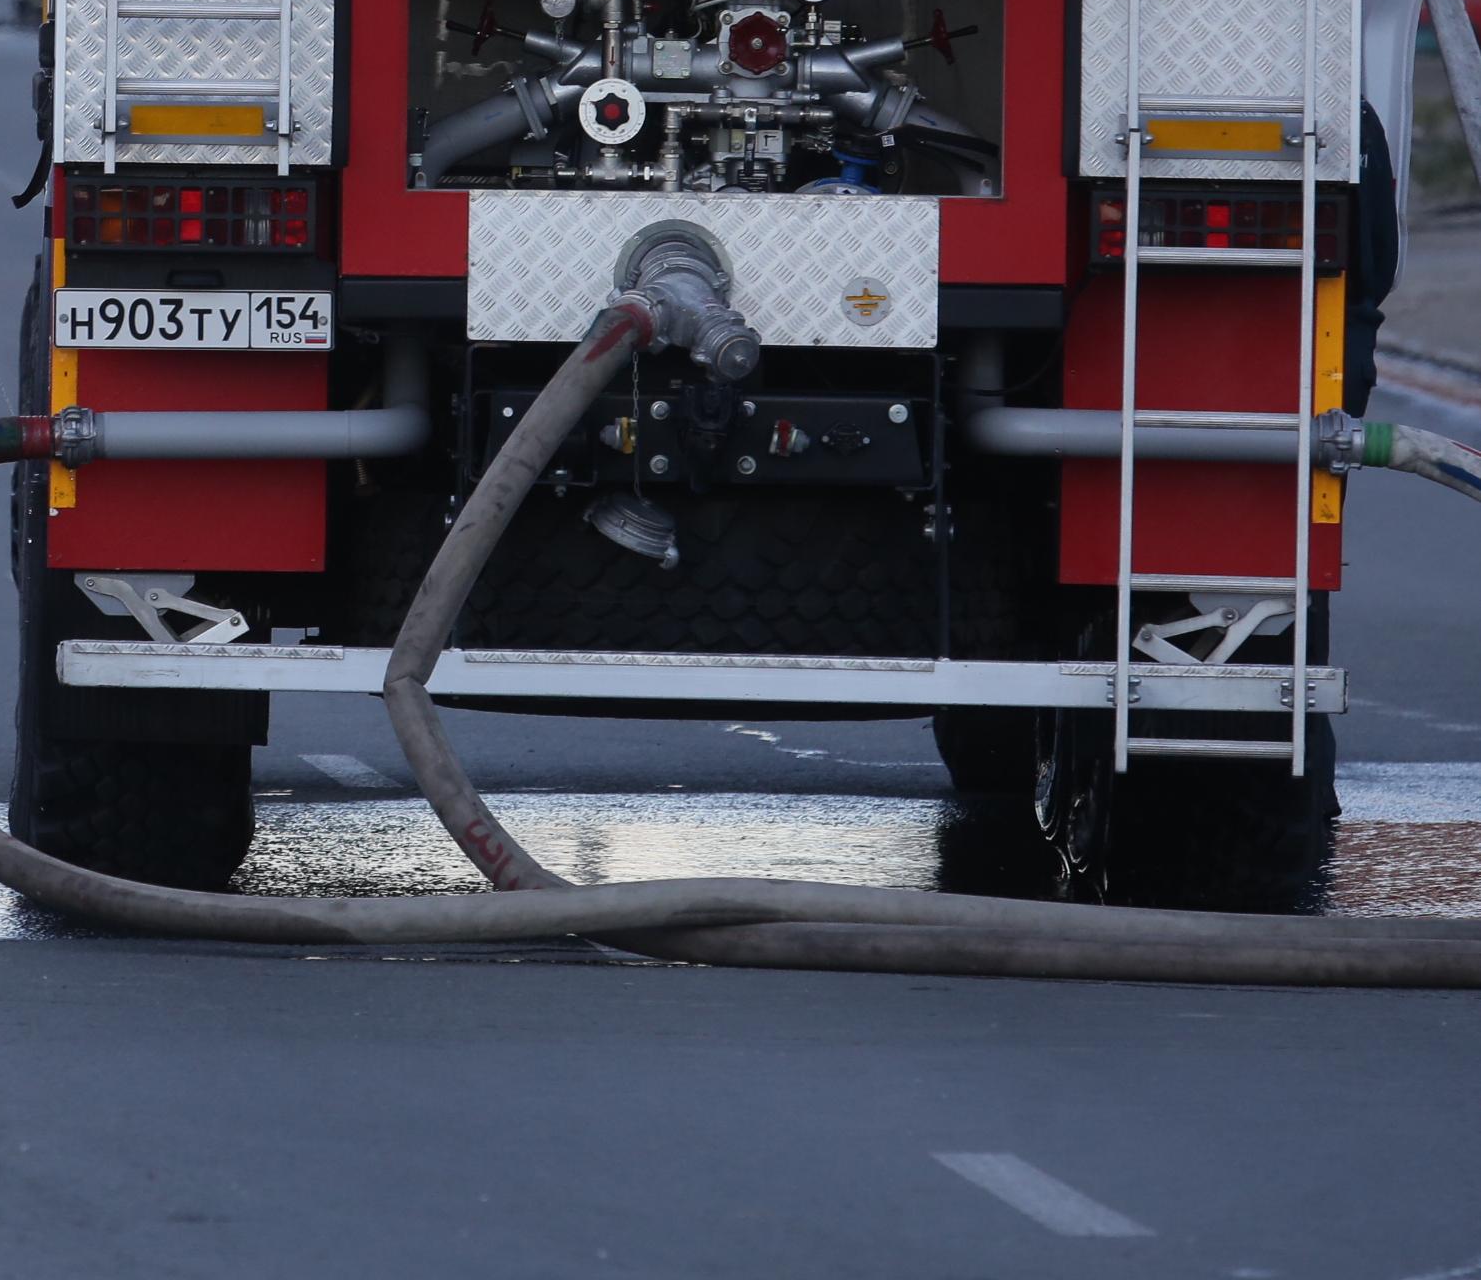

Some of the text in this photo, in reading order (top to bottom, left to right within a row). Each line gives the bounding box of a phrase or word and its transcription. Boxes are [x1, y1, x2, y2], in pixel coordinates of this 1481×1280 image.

[70, 297, 319, 341] Н903ТУ 154
[270, 332, 302, 344] RUS
